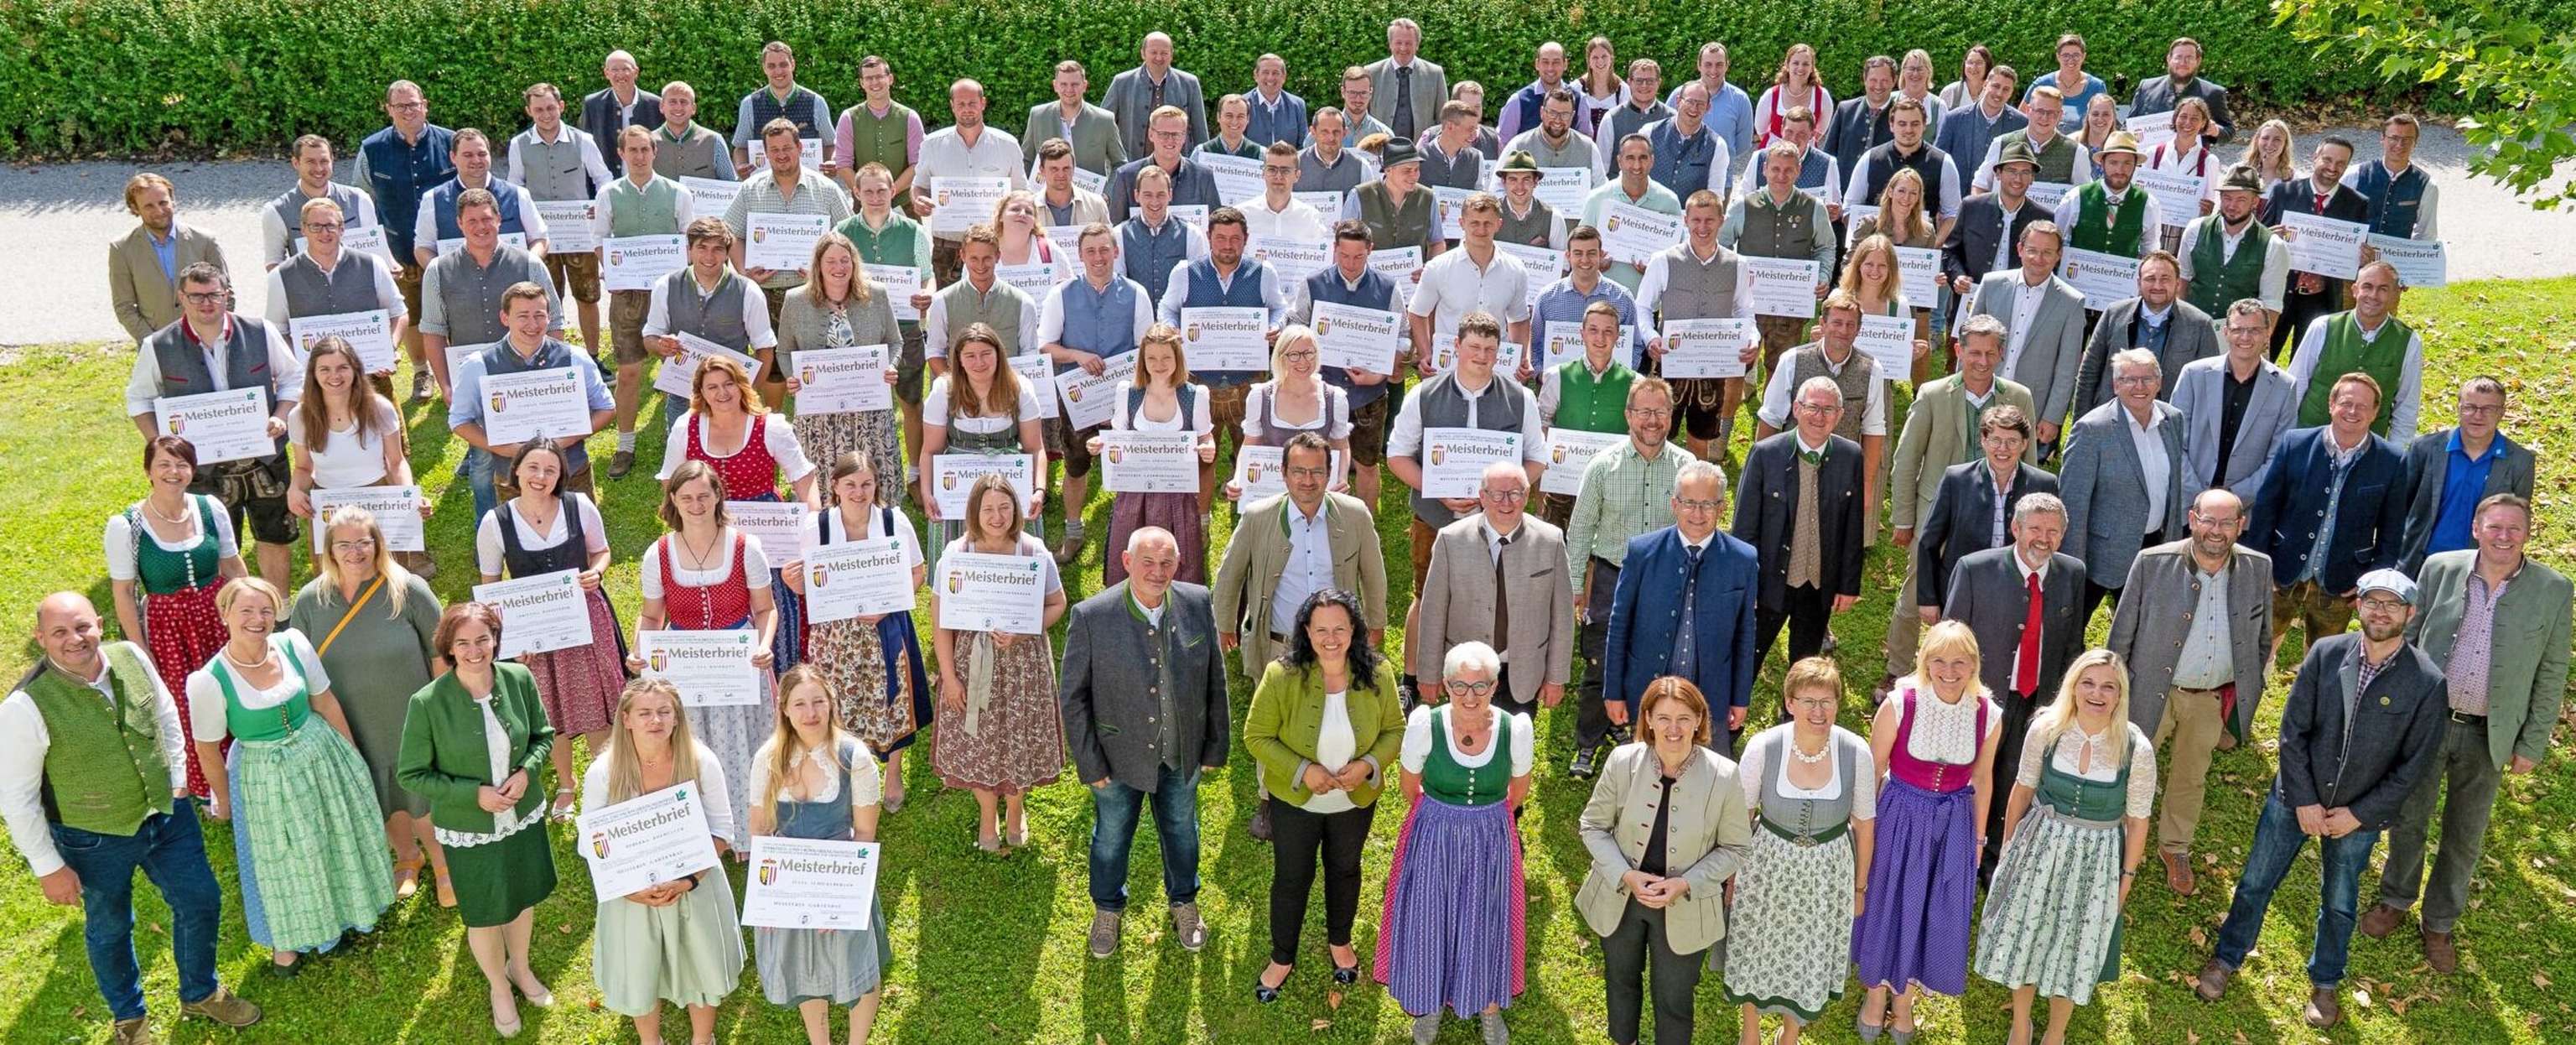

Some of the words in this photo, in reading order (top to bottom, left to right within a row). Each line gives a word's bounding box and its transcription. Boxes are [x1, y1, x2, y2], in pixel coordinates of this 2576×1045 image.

[1216, 165, 1264, 177] Meisterbrie
[950, 189, 1004, 199] Meisterbrief
[2145, 181, 2197, 195] Meisterbrief
[766, 226, 822, 237] Meisterbrief
[1621, 216, 1675, 238] Meisterbrief
[2299, 226, 2359, 244] Meisterbrief
[623, 246, 679, 257] Meisterbrief
[1268, 248, 1326, 263] Meisterbrief
[2382, 247, 2439, 258] Meisterbrief
[1755, 271, 1810, 282] Meisterbrief
[2080, 263, 2135, 279] Meisterbrief
[1201, 321, 1260, 331] Meisterbrief
[1331, 315, 1392, 335] Meisterbrief
[1681, 331, 1741, 341] Meisterbrief
[816, 361, 879, 374] Meisterbrief
[1079, 367, 1135, 391] Meisterbrie
[506, 382, 577, 400] Meisterbrief
[184, 403, 257, 422] Meisterbrief
[1123, 444, 1188, 455] Meisterbrief
[1446, 444, 1514, 457] Meisterbrief
[828, 553, 901, 572] Meisterbrief
[964, 570, 1036, 585] Meisterbrief
[503, 589, 574, 610] Meisterbrief
[668, 646, 749, 660] Meisterbrief
[607, 802, 691, 840] Meisterbrief
[779, 858, 866, 876] Meisterbrief
